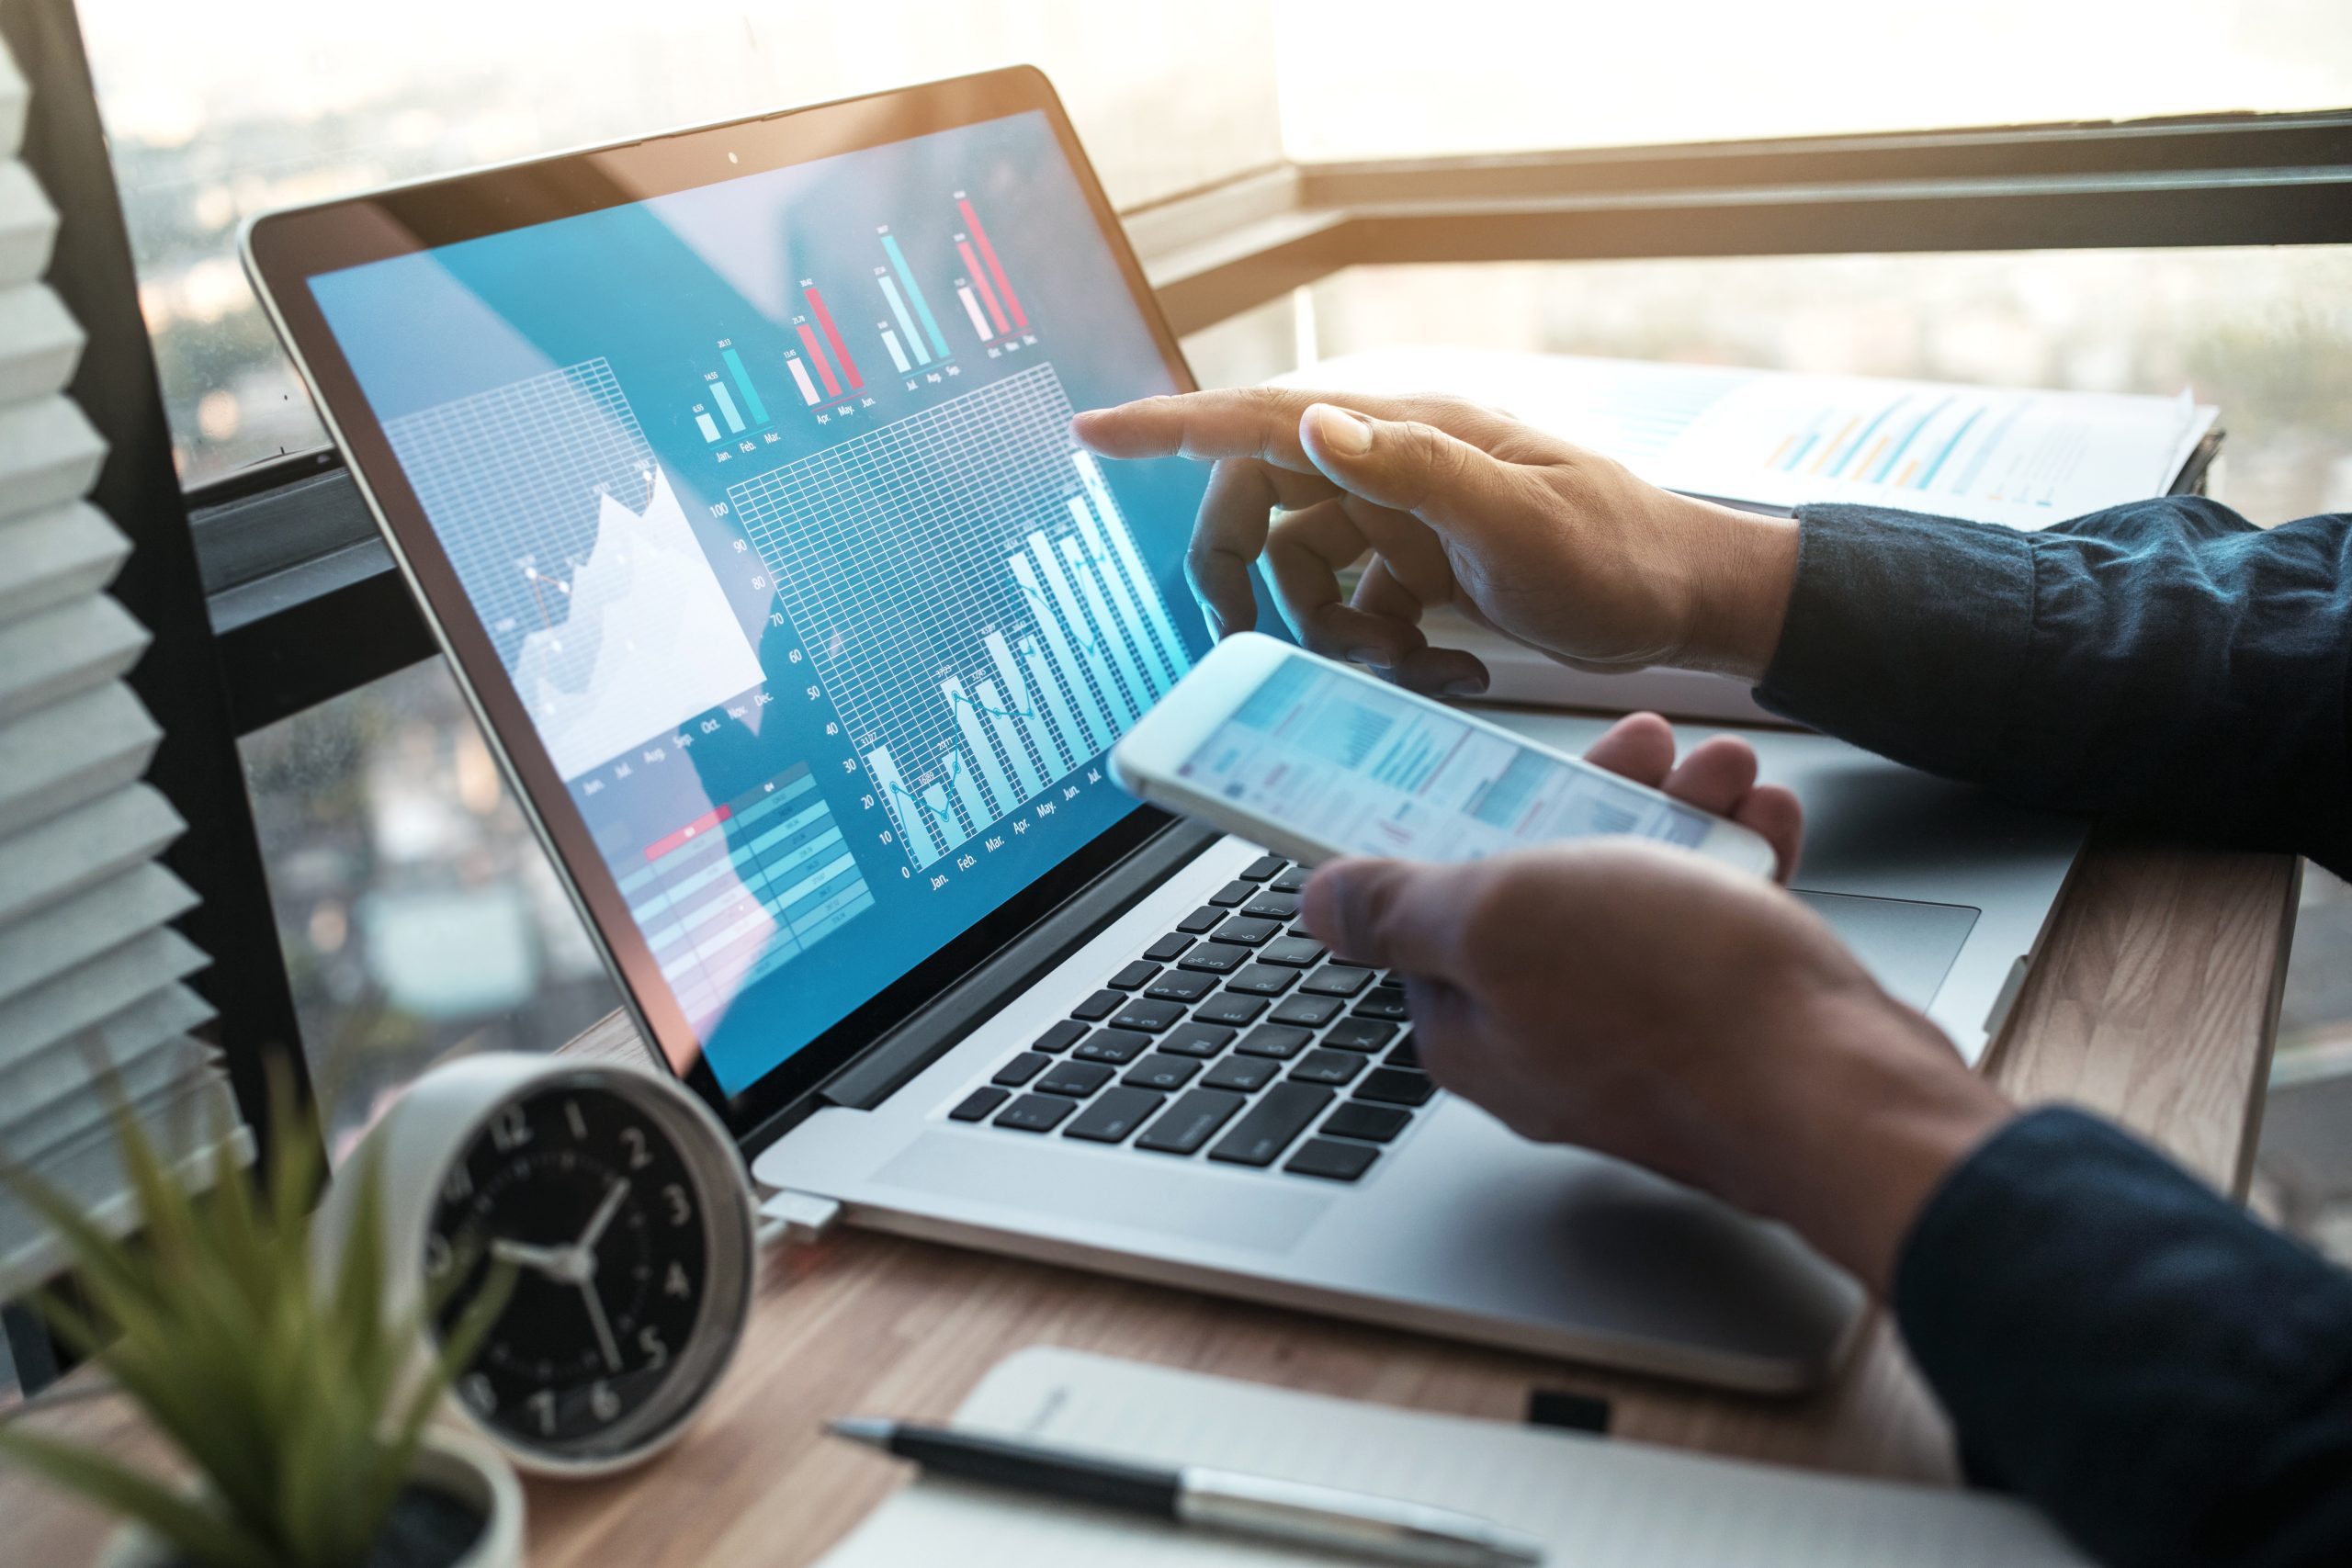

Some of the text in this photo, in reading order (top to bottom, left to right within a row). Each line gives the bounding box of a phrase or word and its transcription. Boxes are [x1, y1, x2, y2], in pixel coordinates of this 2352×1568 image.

[816, 397, 876, 424] Apr. May. Jun.
[717, 432, 781, 463] Jan. Feb. Mar.
[709, 502, 729, 518] 100
[733, 539, 747, 553] 90
[752, 576, 765, 590] 80
[770, 612, 785, 627] 70
[788, 649, 802, 663] 60
[807, 685, 820, 700] 50
[826, 722, 839, 736] 40
[842, 759, 856, 773] 30
[860, 795, 875, 810] 20
[879, 830, 893, 845] 10
[931, 768, 1102, 891] Jan. Feb. Mar. Apr. May. Jun. Jul.
[901, 867, 910, 878] 0
[564, 1098, 587, 1140] 1
[619, 1126, 654, 1169] 2
[663, 1183, 691, 1225] 3
[663, 1260, 690, 1300] 4
[639, 1327, 668, 1371] 5
[590, 1381, 621, 1421] 6
[526, 1390, 556, 1435] 7
